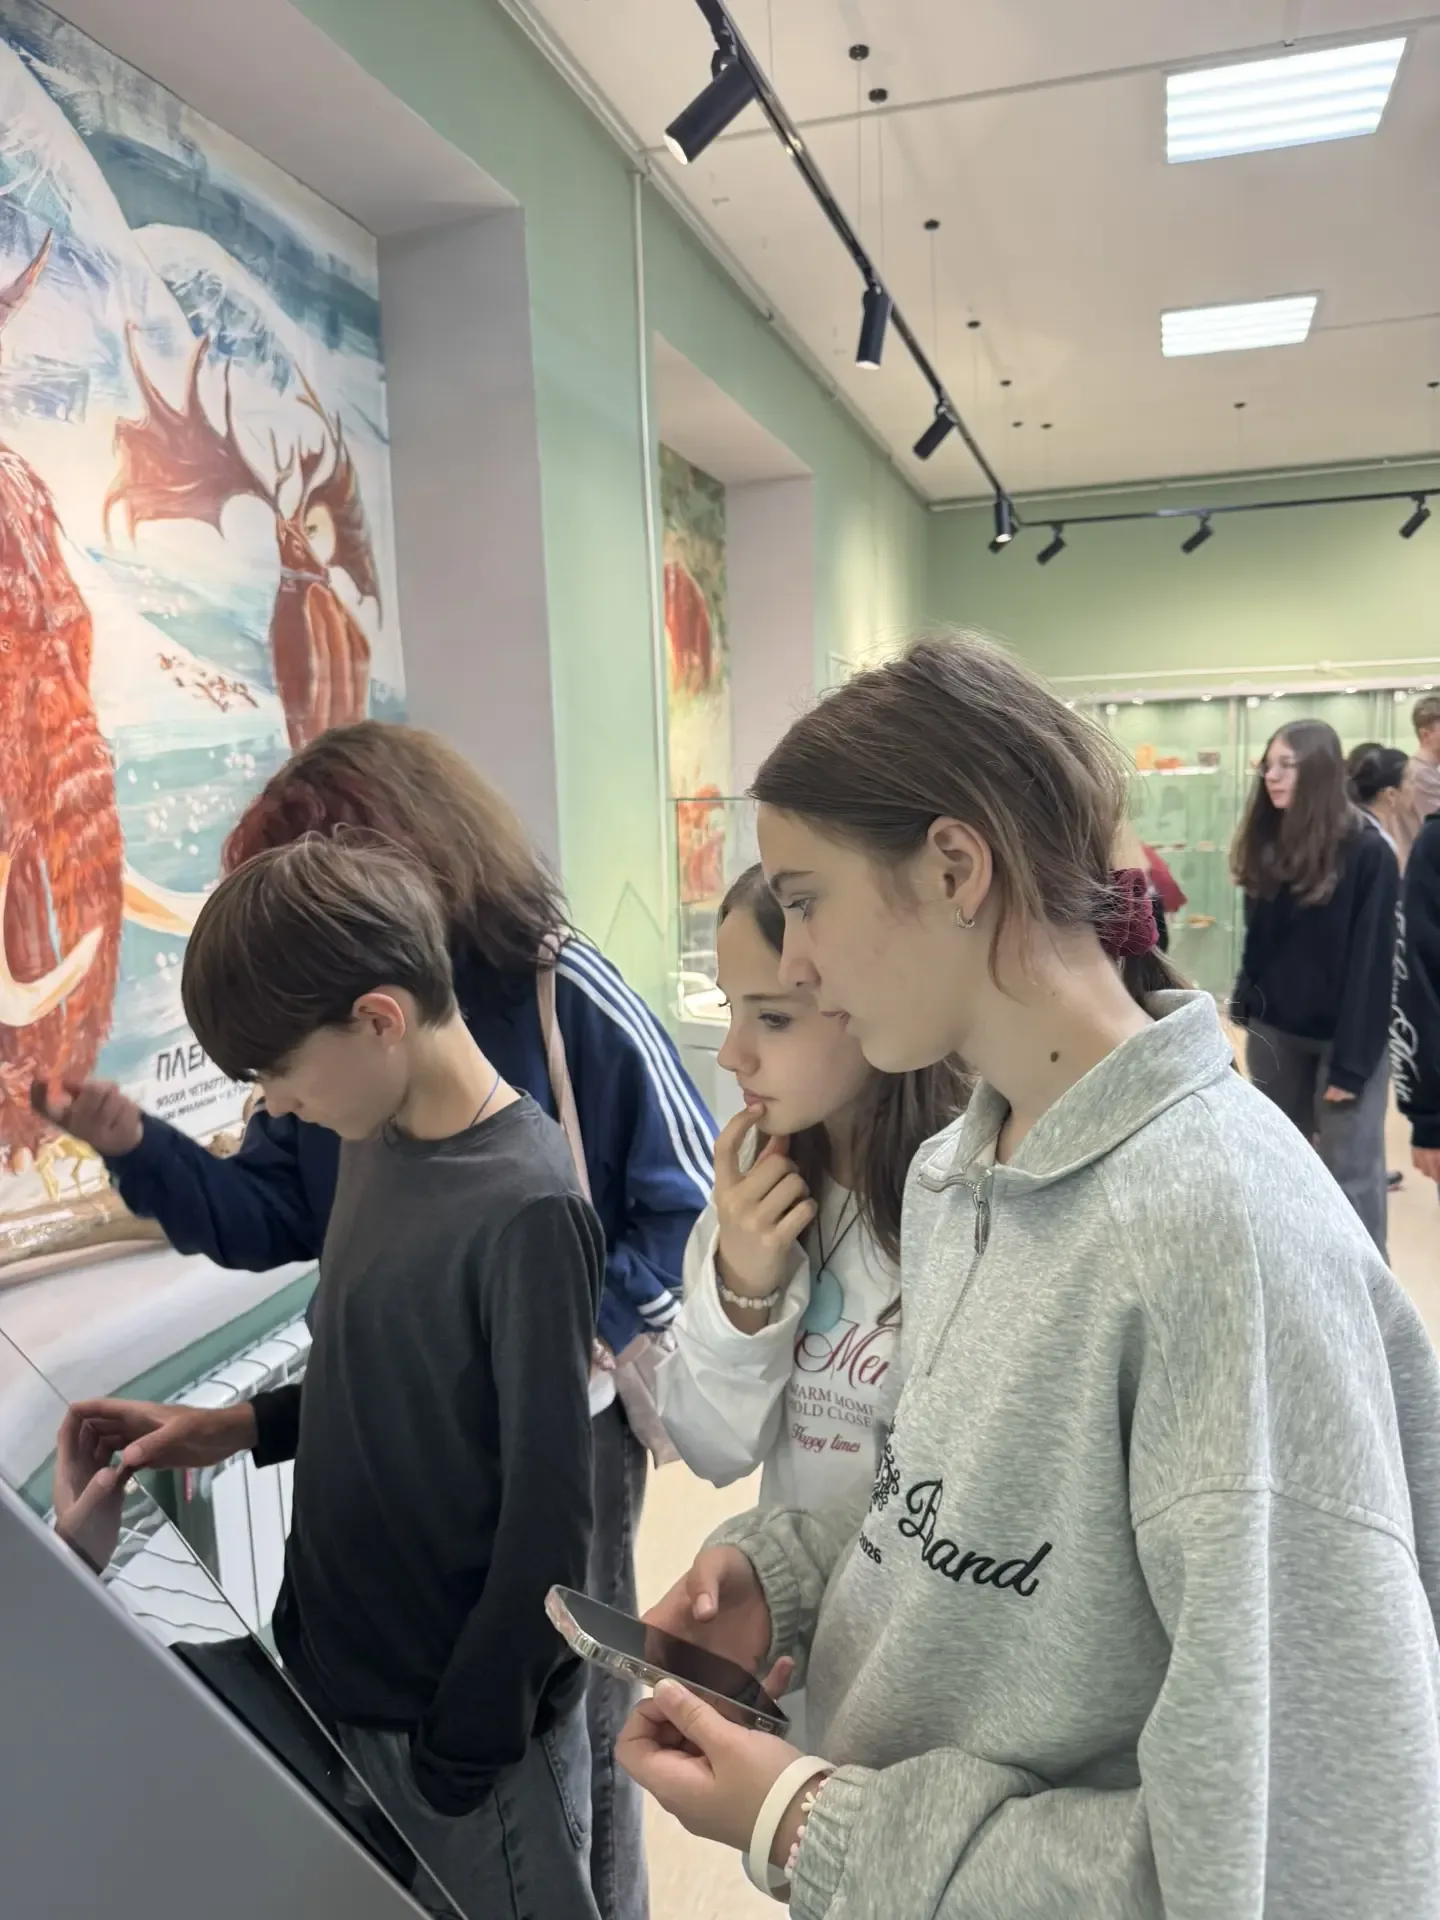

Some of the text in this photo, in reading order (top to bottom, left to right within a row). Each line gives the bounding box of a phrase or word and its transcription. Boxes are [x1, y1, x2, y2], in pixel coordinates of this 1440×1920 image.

[157, 1043, 206, 1082] ПЛЕ
[826, 1405, 874, 1429] CLOSE
[791, 1422, 861, 1454] Happy times
